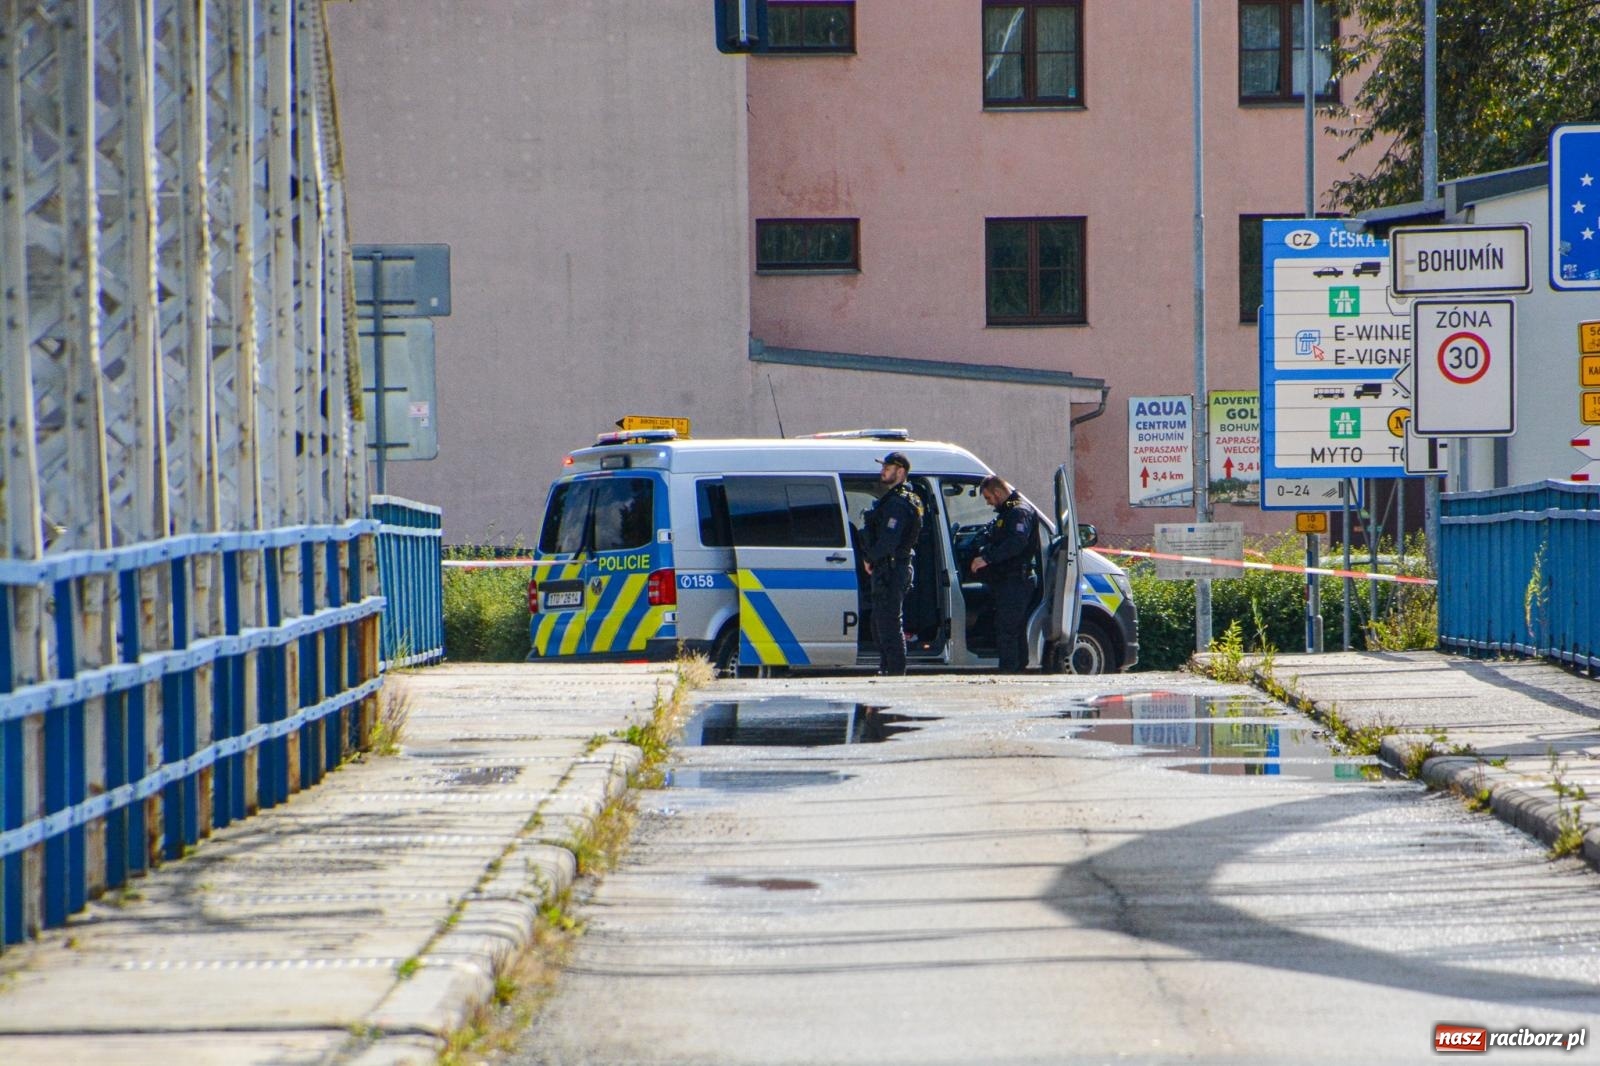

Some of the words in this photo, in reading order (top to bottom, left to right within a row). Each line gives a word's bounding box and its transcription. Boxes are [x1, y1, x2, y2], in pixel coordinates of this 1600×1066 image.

[1292, 233, 1312, 247] CZ
[1418, 243, 1504, 272] BOHUMÍN
[1436, 307, 1492, 328] ZÓNA
[1449, 347, 1478, 369] 30
[1135, 401, 1187, 416] AQUA
[1226, 408, 1259, 420] GOL
[1135, 420, 1187, 430] CENTRUM
[1138, 431, 1184, 442] BOHUMÍN
[1134, 445, 1188, 454] ZAPRASZAMY
[1310, 447, 1363, 463] MYTO
[1140, 455, 1182, 464] WELCOME
[1237, 462, 1254, 472] 3,4
[1152, 472, 1167, 481] 3,4
[1169, 471, 1184, 480] km
[598, 554, 650, 571] POLICIE
[691, 575, 714, 588] 158
